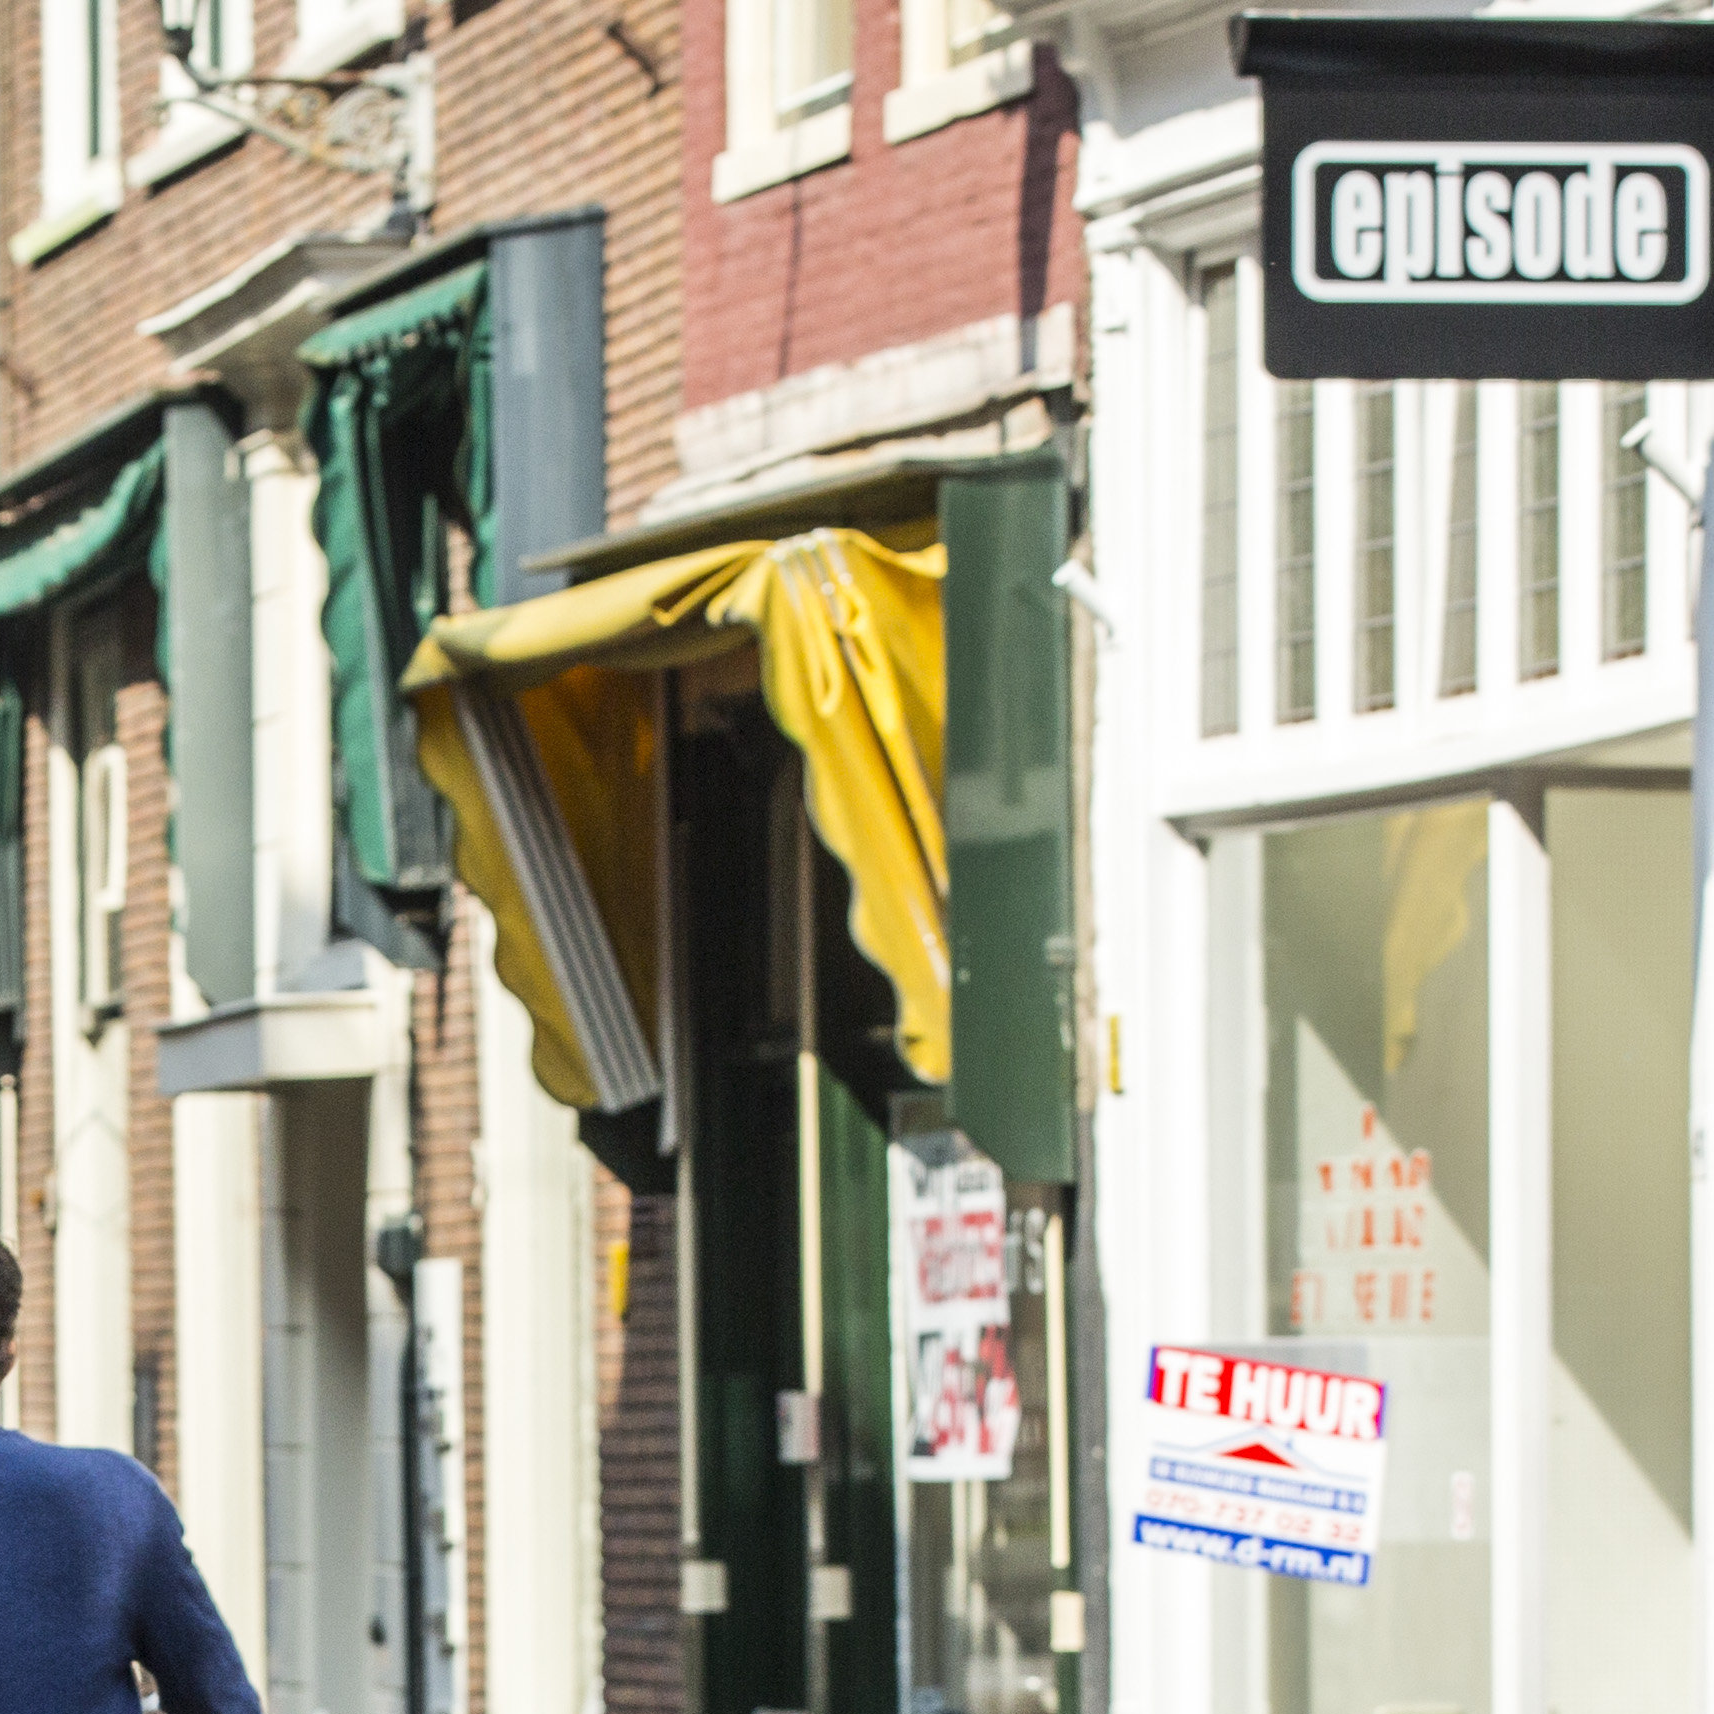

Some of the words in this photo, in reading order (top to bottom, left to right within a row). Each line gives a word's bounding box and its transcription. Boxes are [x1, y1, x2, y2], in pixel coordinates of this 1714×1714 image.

[1331, 160, 1669, 283] episode
[1156, 1349, 1224, 1415] TE
[1229, 1361, 1381, 1439] HUUR
[1140, 1519, 1365, 1584] www.d-rm.nl
